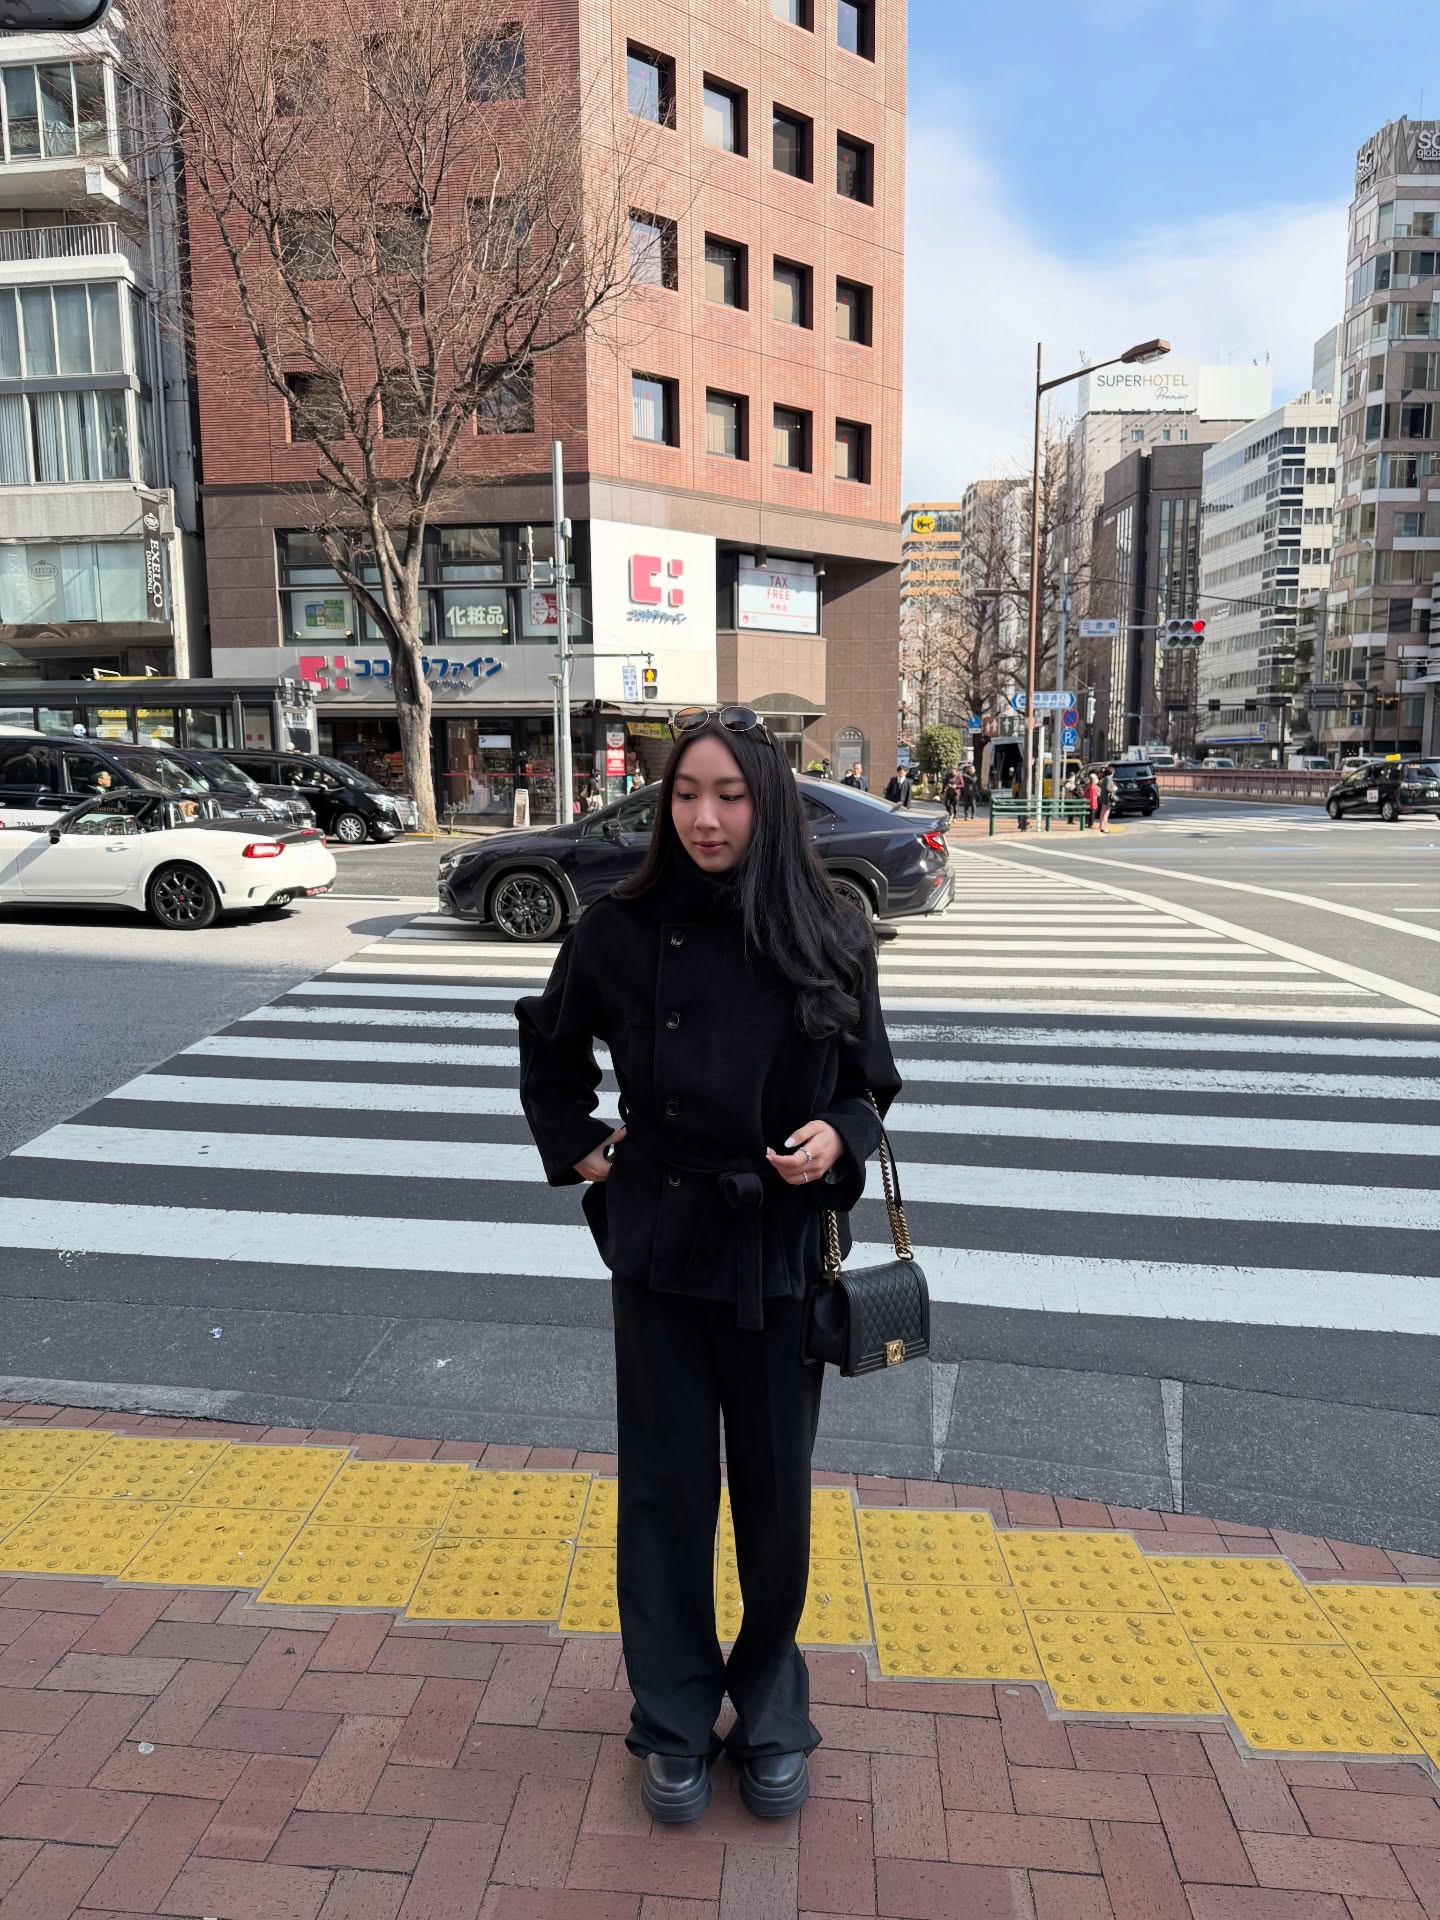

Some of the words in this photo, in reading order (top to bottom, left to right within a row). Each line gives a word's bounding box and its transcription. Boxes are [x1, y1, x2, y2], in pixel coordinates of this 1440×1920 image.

[145, 550, 153, 594] DIAMOND
[150, 539, 163, 608] EXELCO
[769, 575, 788, 588] TAX
[767, 588, 790, 601] FREE
[446, 605, 505, 625] 化粧品
[354, 656, 503, 678] ココラファイン
